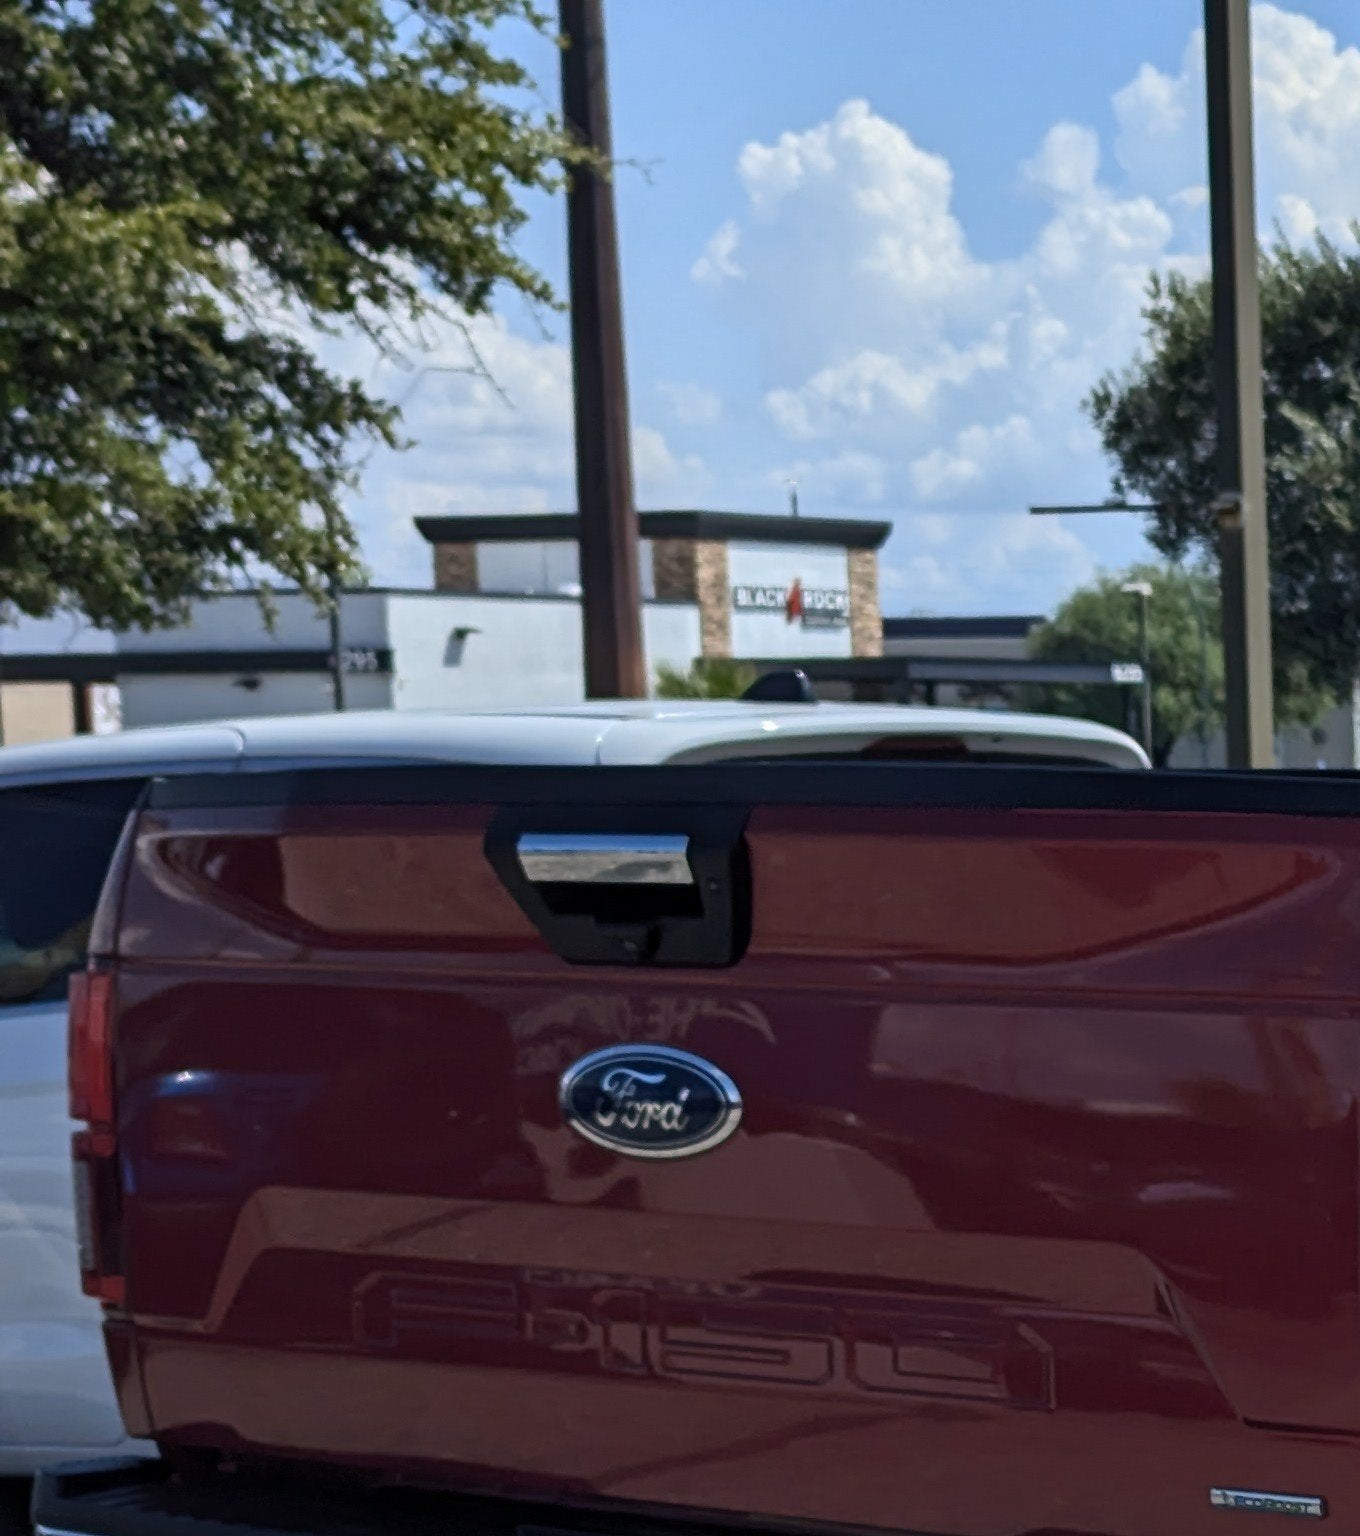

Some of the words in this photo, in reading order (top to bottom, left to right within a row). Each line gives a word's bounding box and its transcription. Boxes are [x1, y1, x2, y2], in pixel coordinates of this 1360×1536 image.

[736, 587, 787, 608] BLACK
[803, 589, 849, 610] ROCK
[597, 1067, 691, 1131] Ford
